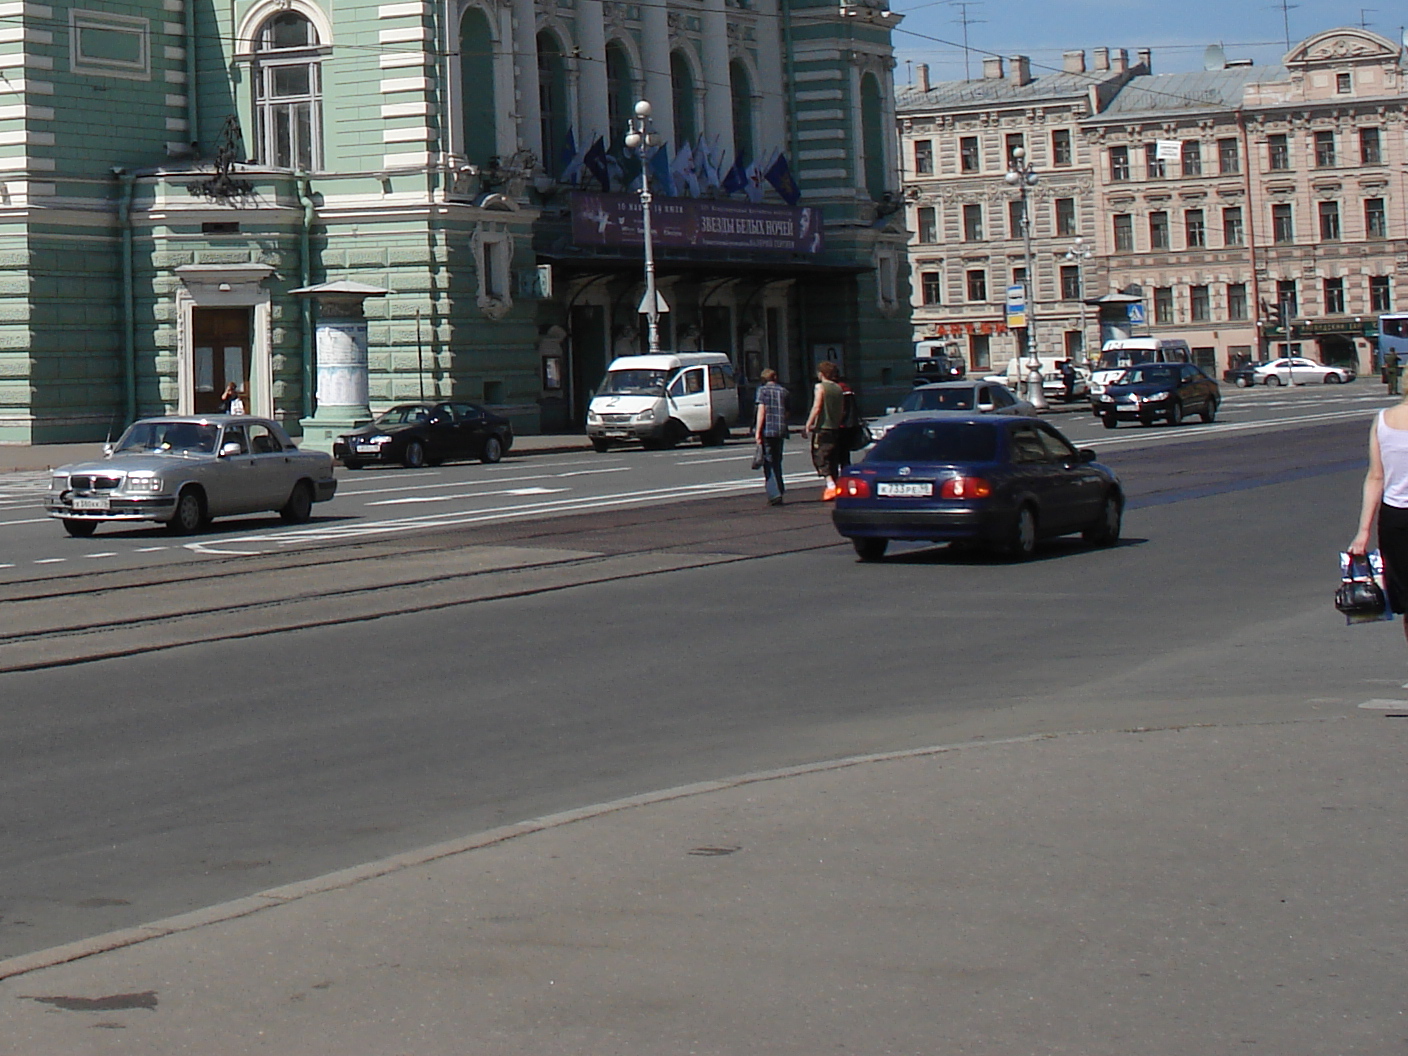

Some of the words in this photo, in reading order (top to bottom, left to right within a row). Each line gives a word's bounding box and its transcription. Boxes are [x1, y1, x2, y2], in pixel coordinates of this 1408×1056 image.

[701, 216, 734, 233] ЗВЕЗДЫ
[736, 217, 765, 235] БЕЛЫХ
[765, 218, 794, 236] НОЧЕЙ
